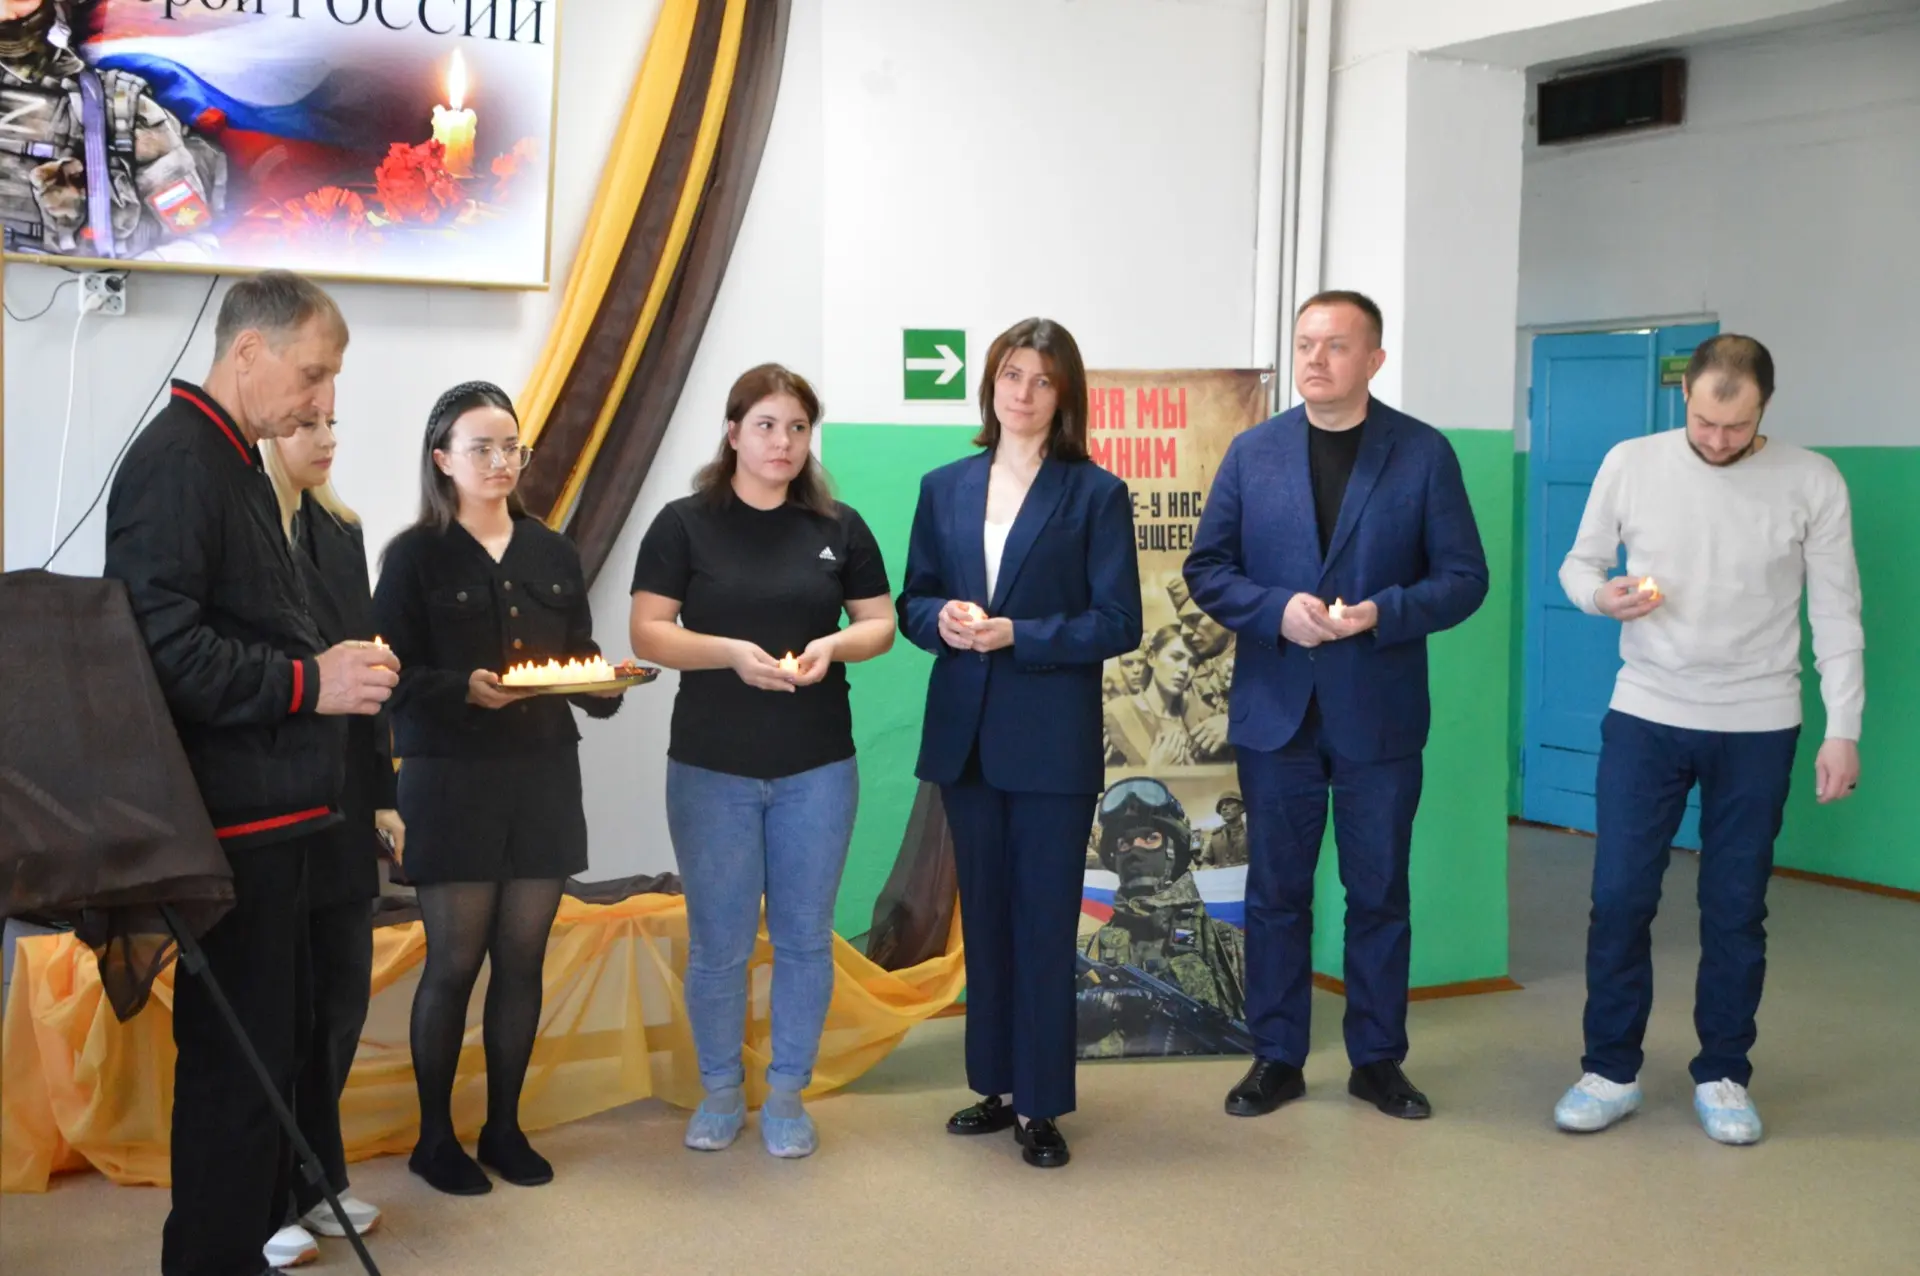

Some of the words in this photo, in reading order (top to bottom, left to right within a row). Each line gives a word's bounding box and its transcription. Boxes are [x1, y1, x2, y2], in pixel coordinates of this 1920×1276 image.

[1089, 387, 1125, 430] КА
[1137, 387, 1187, 430] МЫ
[1091, 437, 1177, 479] МНИМ
[1130, 491, 1161, 518] Е-У
[1168, 491, 1202, 518] НАС
[1138, 524, 1193, 552] УЩЕЕ!
